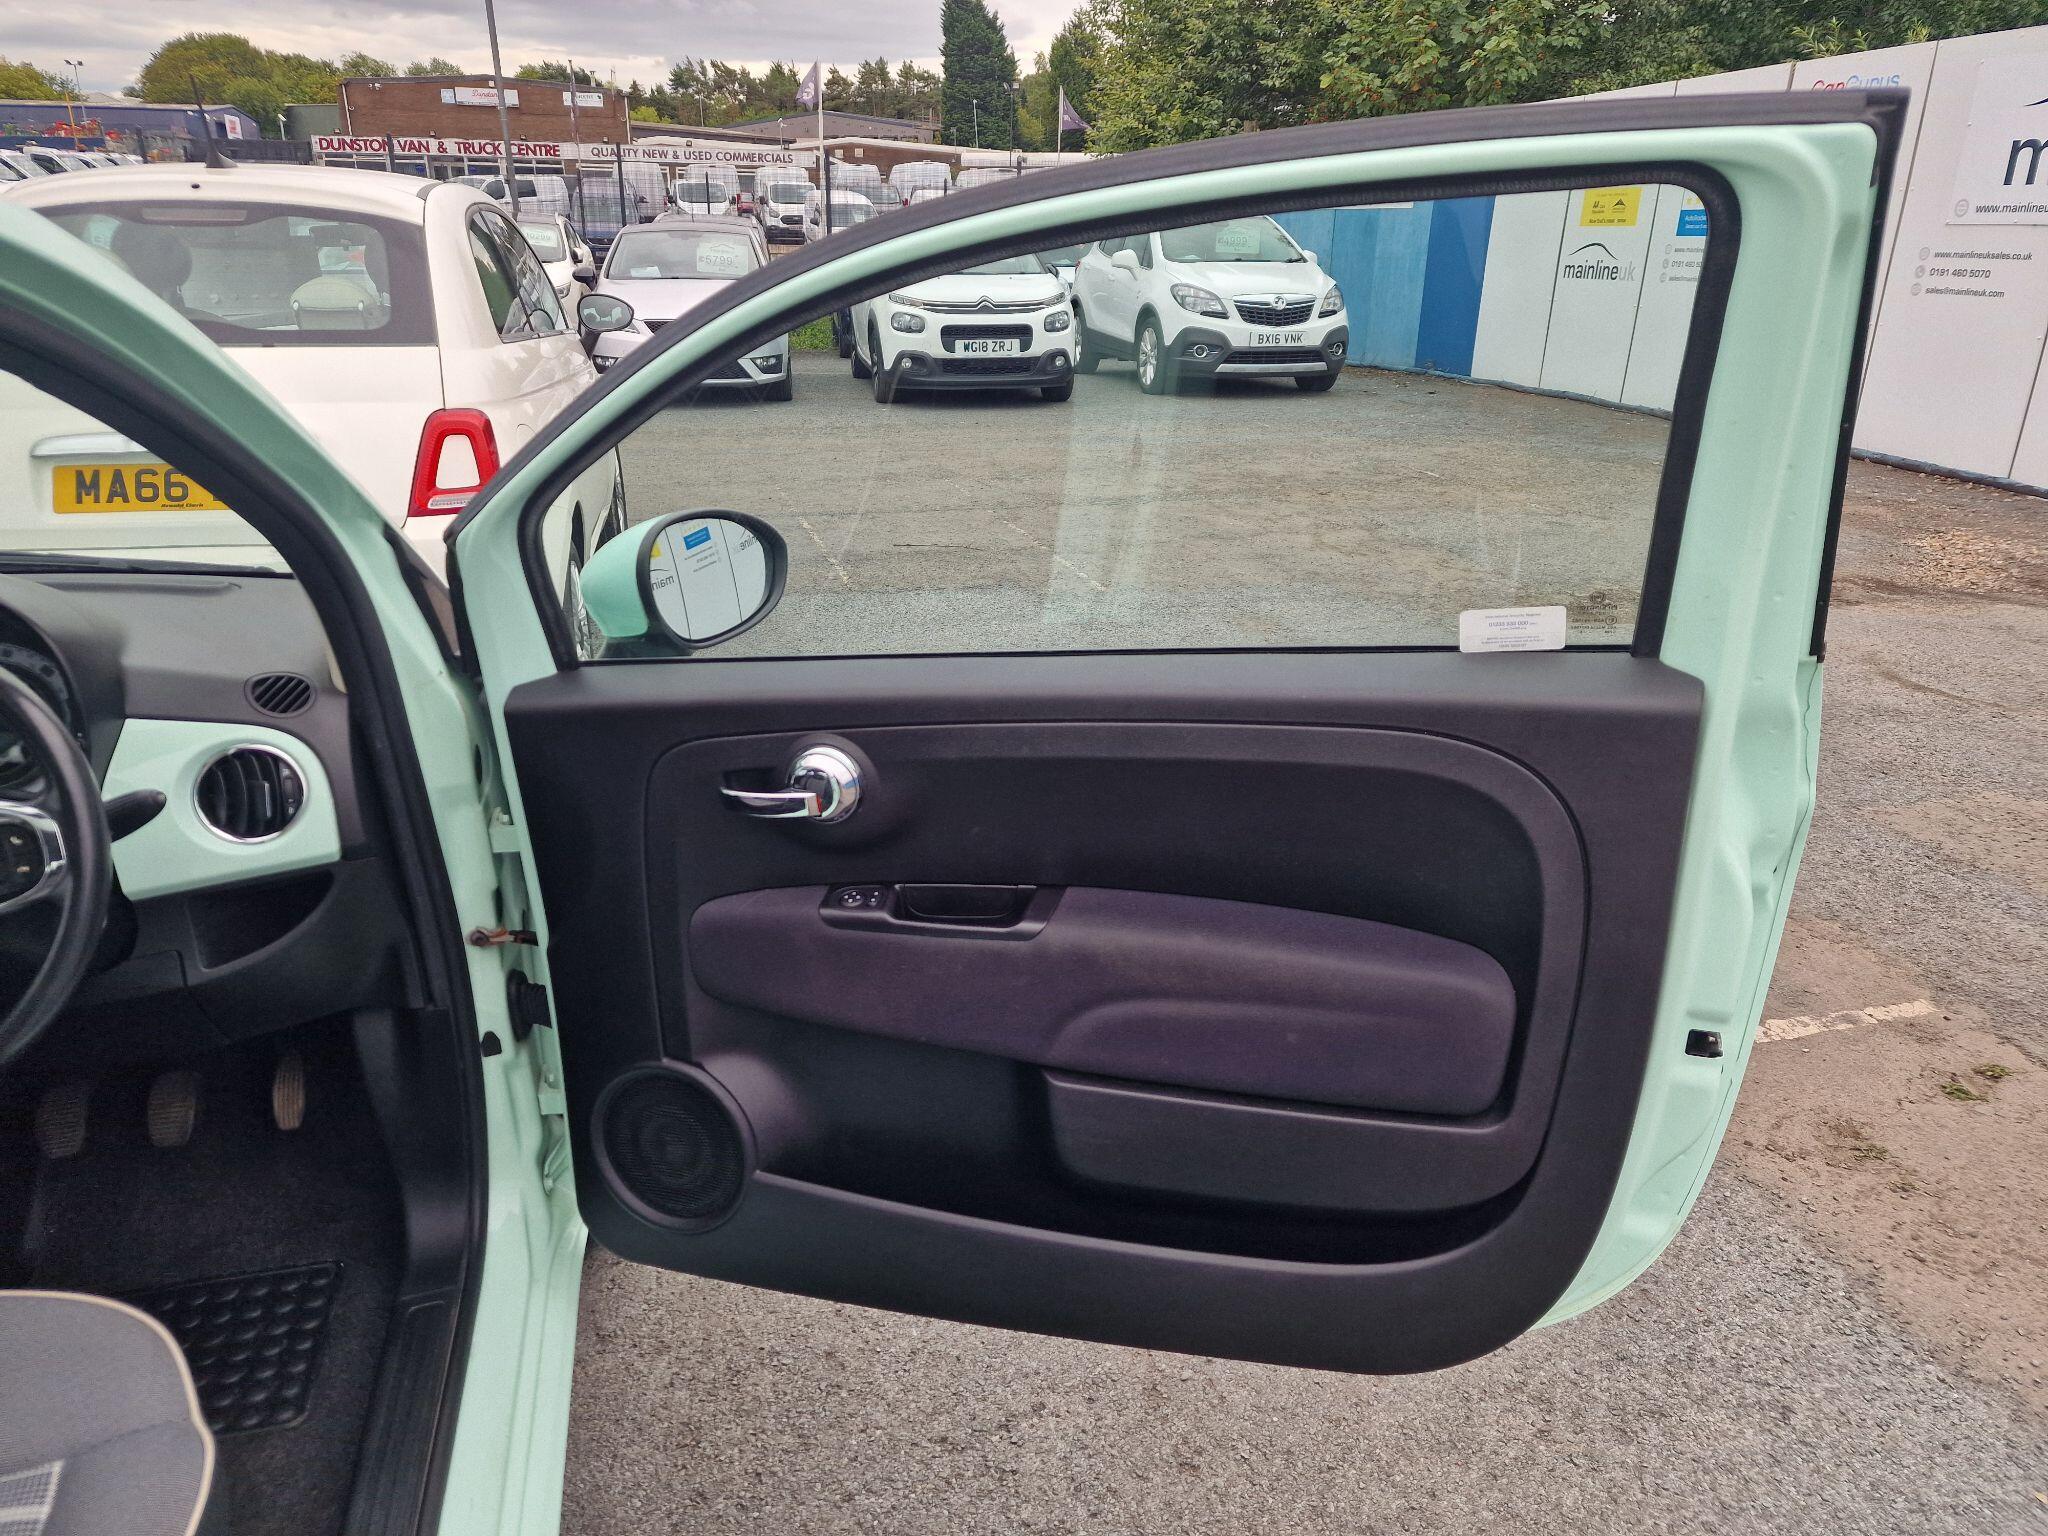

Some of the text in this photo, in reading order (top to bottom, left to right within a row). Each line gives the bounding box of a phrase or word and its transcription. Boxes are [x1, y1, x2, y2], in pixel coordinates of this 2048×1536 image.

[398, 139, 431, 154] VAN
[437, 140, 448, 154] &
[455, 141, 502, 156] TRUCK
[510, 142, 561, 157] CENTRE
[642, 148, 669, 160] NEW
[672, 149, 681, 160] &
[683, 149, 712, 161] USED
[715, 151, 794, 164] COMMERCIALS
[1934, 250, 2033, 261] www.mainlineuksales.co.uk
[1563, 259, 1636, 282] mainlineuk
[1929, 268, 1992, 279] 0191 460 5070
[1925, 286, 2005, 298] sales@mainlineuk.com
[1257, 333, 1304, 345] BX16 VNK
[963, 341, 1013, 353] WG18 ZRJ
[75, 468, 189, 505] MA66
